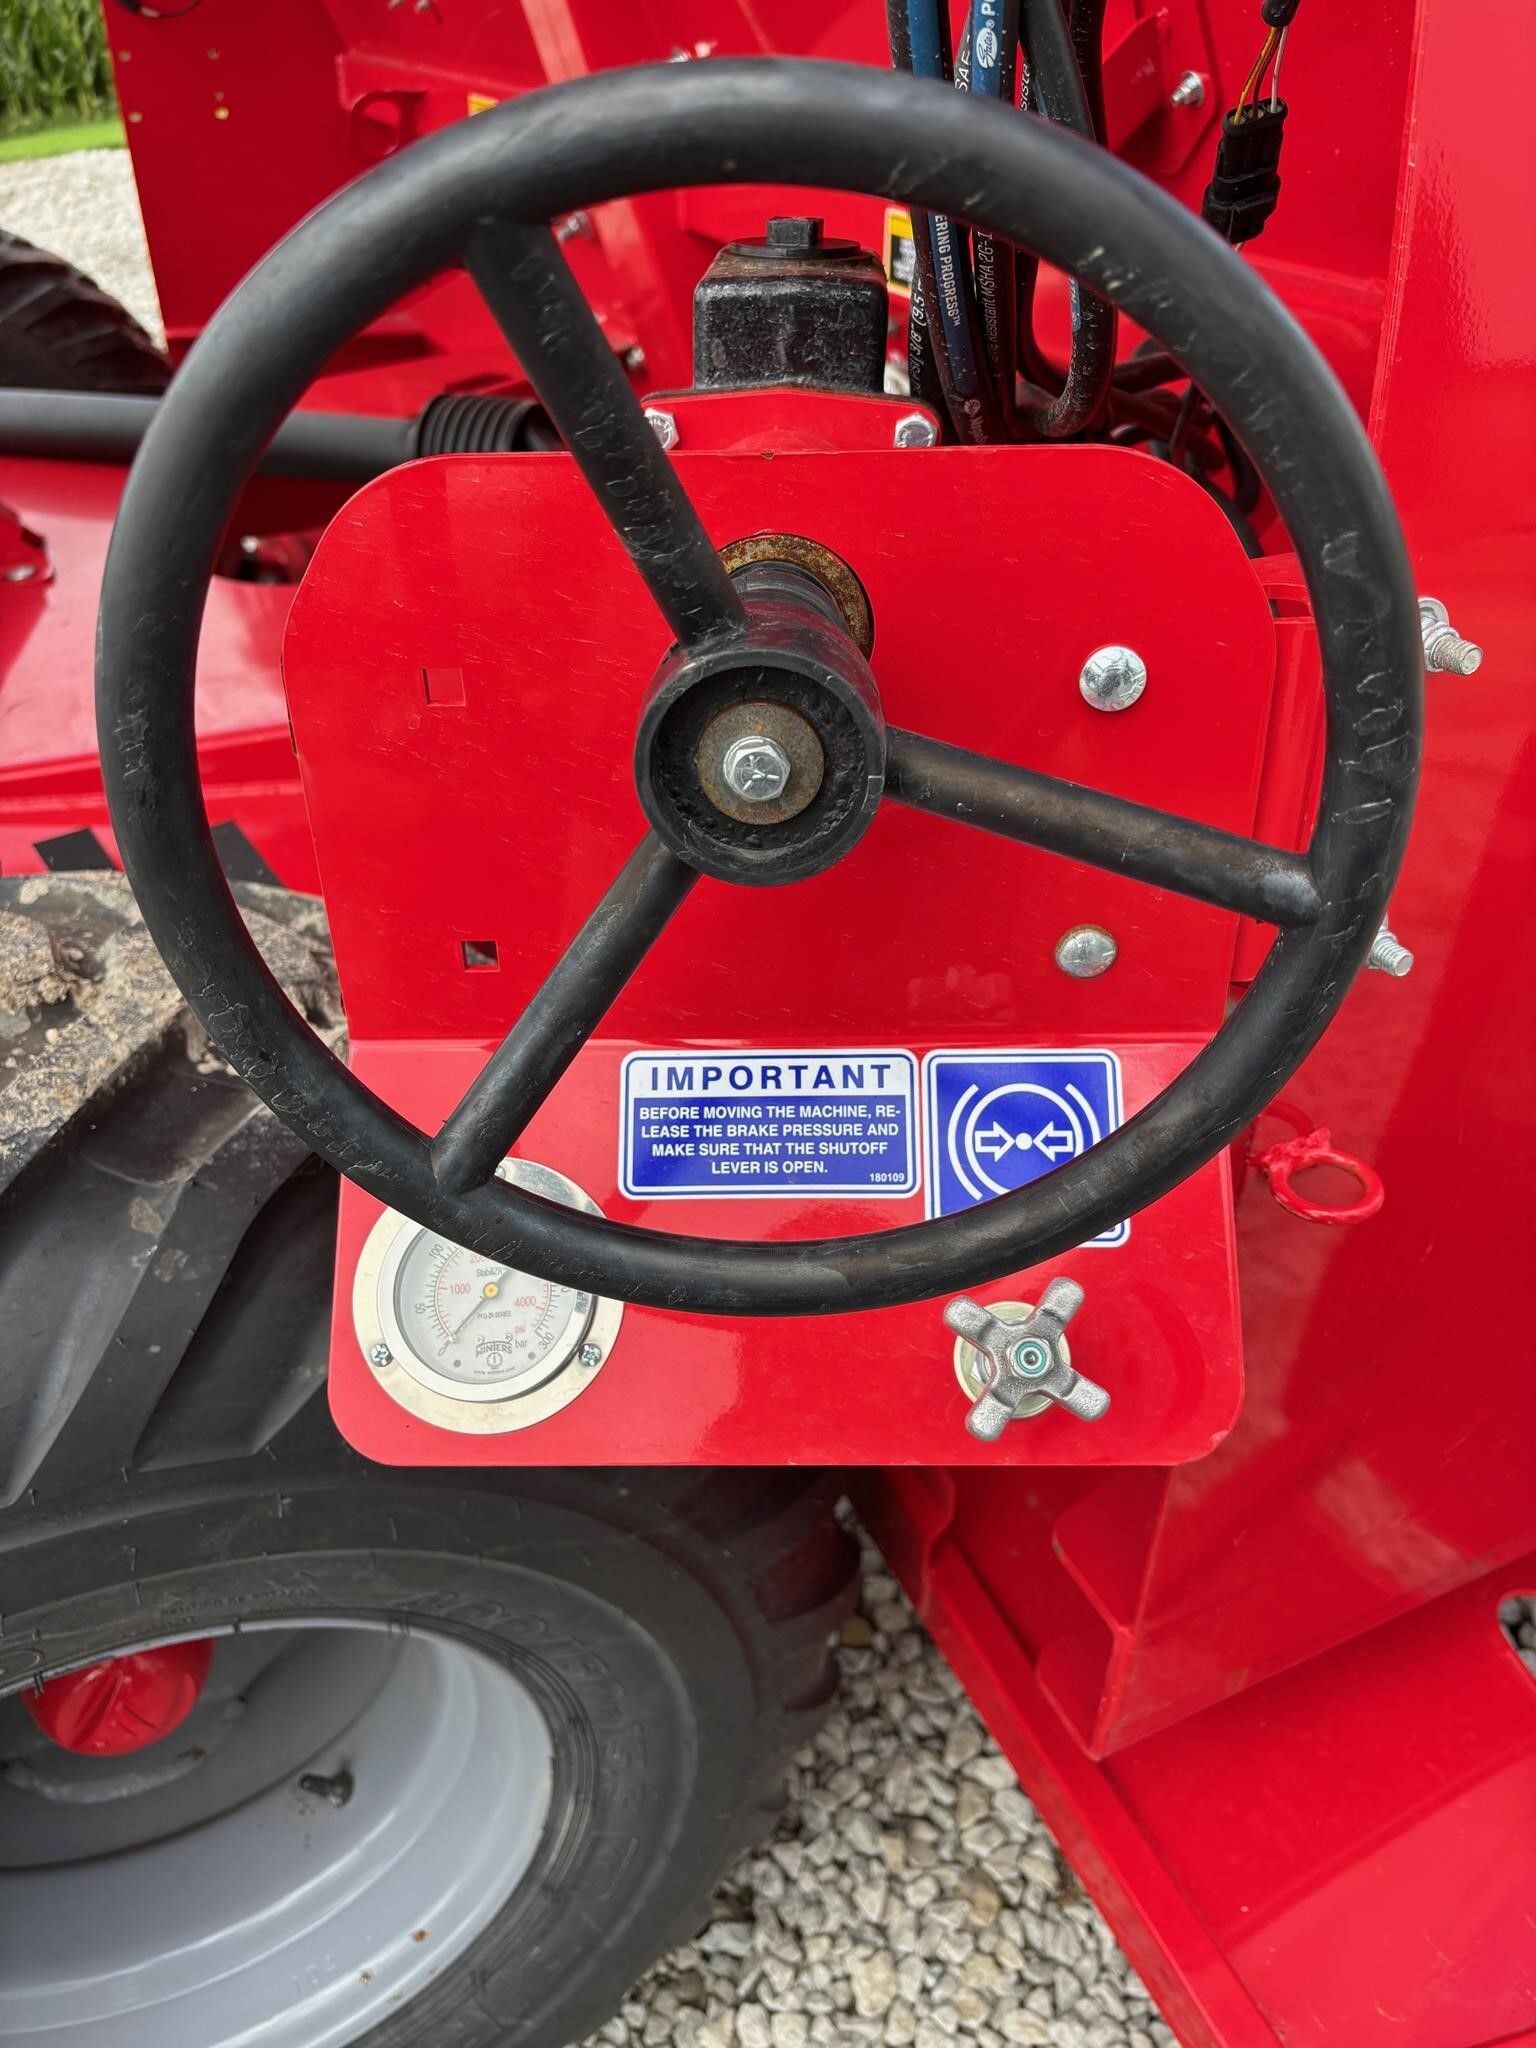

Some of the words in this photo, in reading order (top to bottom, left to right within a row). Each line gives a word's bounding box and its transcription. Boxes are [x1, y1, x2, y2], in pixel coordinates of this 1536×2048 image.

[979, 265, 996, 298] MSHA
[651, 1064, 891, 1091] IMPORTANT
[639, 1106, 700, 1120] BEFORE
[703, 1105, 762, 1119] MOVING
[766, 1105, 796, 1119] THE
[799, 1104, 872, 1120] MACHINE,
[875, 1104, 901, 1118] RE-
[641, 1125, 690, 1139] LEASE
[693, 1124, 723, 1138] THE
[726, 1124, 779, 1137] BRAKE
[782, 1123, 863, 1137] PRESSURE
[866, 1123, 899, 1136] AND
[652, 1143, 695, 1157] MAKE
[698, 1142, 740, 1156] SURE
[743, 1142, 782, 1156] THAT
[785, 1142, 815, 1155] THE
[818, 1141, 888, 1155] SHUTOFF
[711, 1161, 761, 1174] LEVER
[764, 1161, 779, 1174] IS
[782, 1160, 829, 1174] OPEN.
[869, 1172, 905, 1182] 180109
[450, 1283, 471, 1295] 1000
[514, 1295, 537, 1308] 4000
[514, 1338, 528, 1348] bar
[538, 1331, 555, 1350] 300
